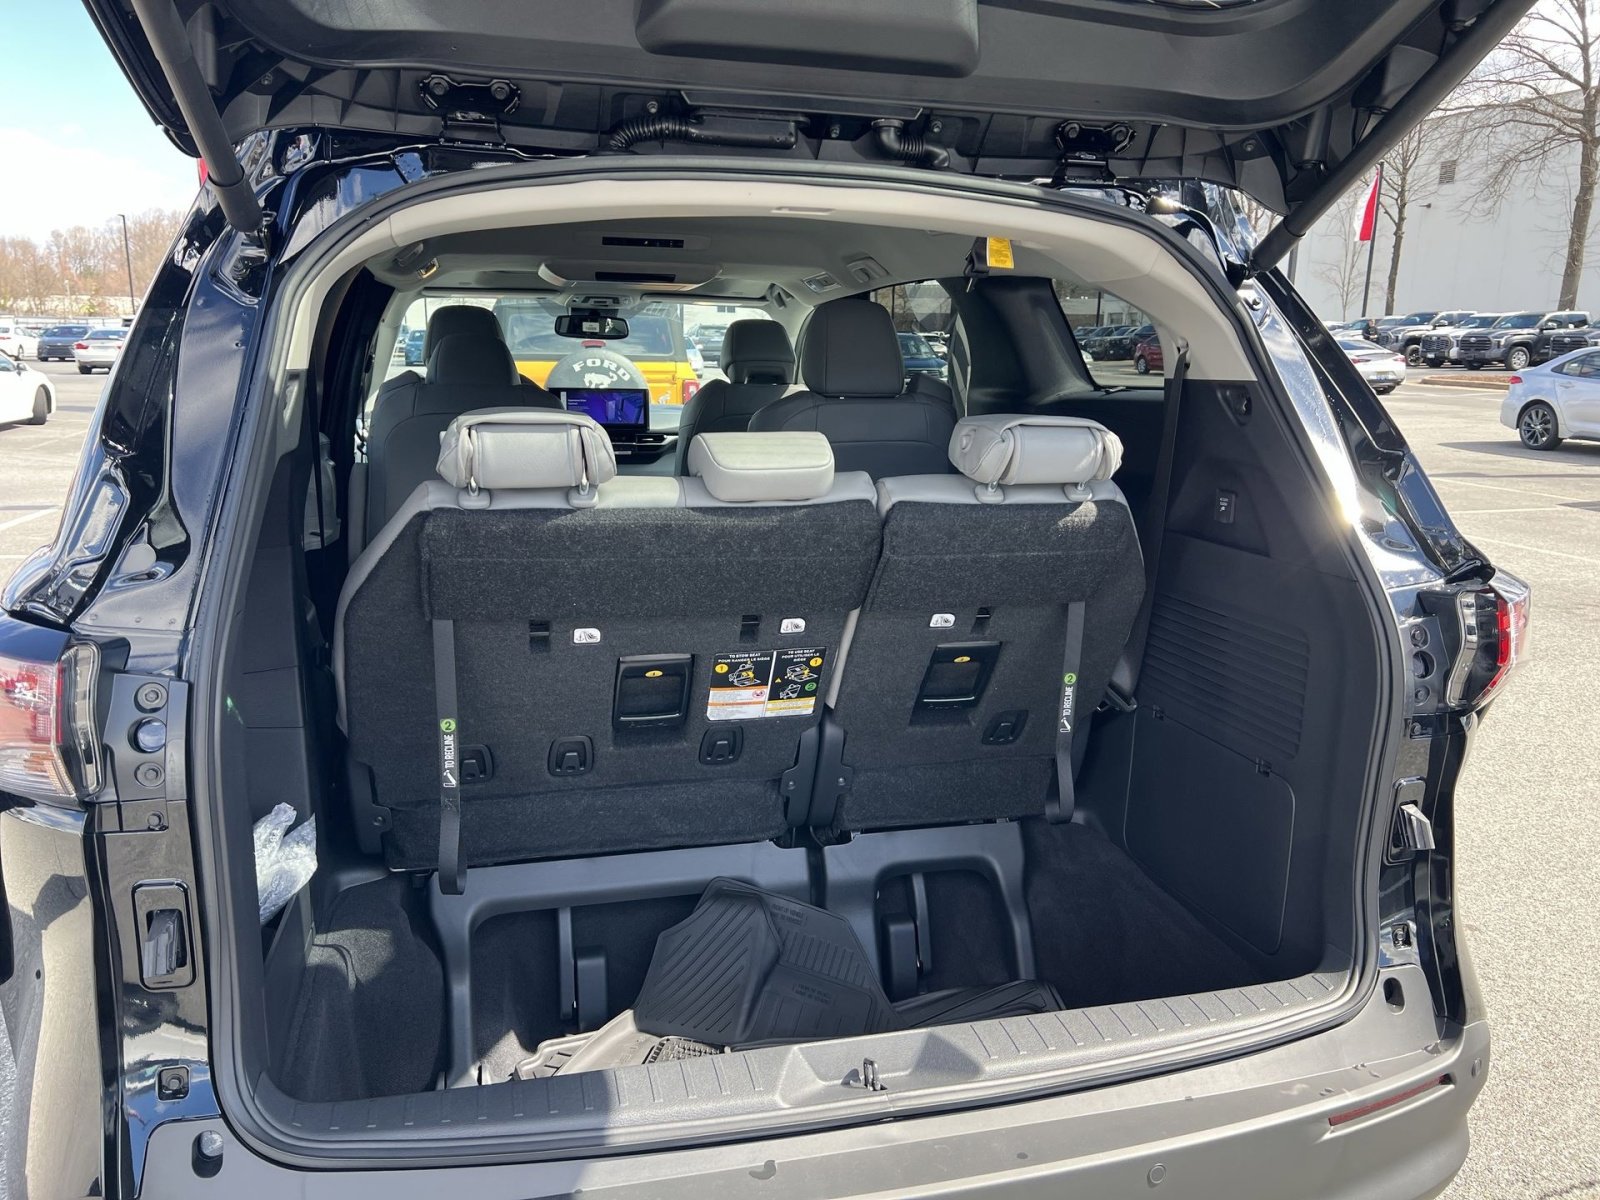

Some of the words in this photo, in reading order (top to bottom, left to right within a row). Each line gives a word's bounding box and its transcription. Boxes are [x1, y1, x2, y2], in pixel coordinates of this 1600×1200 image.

[572, 358, 631, 381] FORD
[1063, 686, 1074, 708] RECLINE
[444, 721, 452, 731] 2
[443, 734, 455, 760] RECLINE
[444, 760, 455, 769] TO
